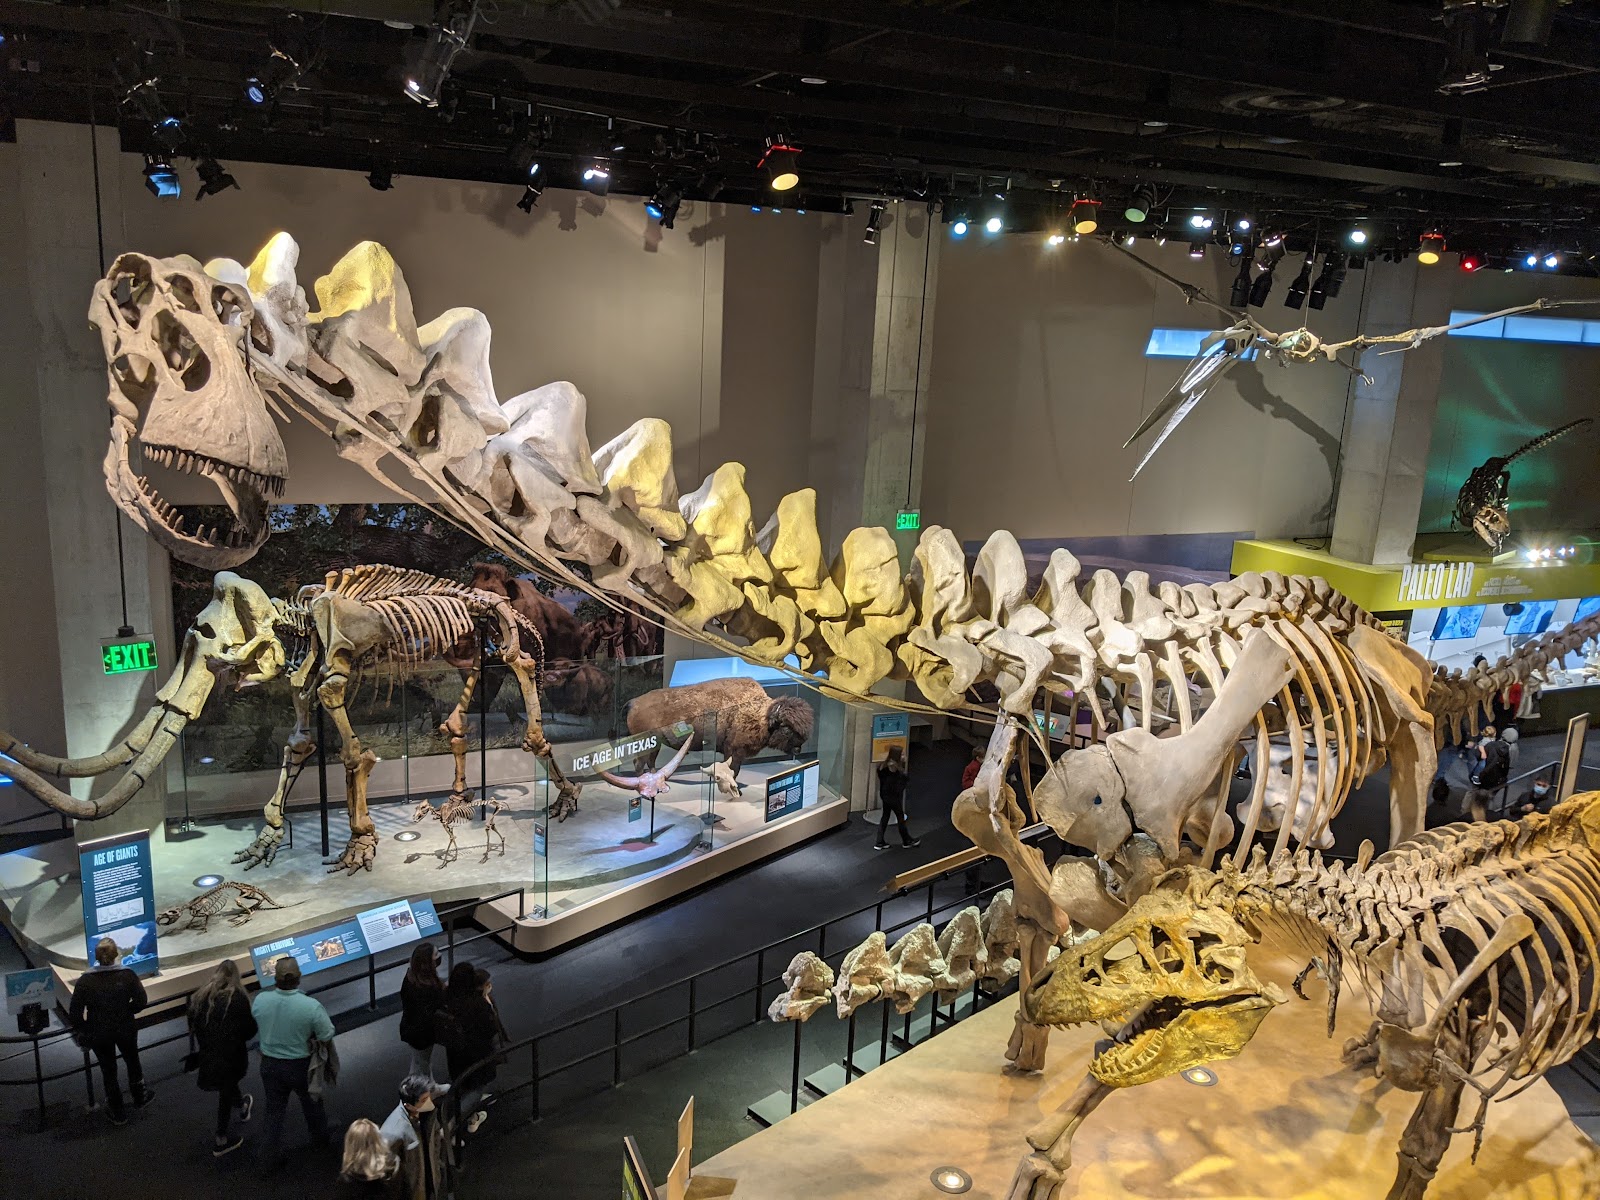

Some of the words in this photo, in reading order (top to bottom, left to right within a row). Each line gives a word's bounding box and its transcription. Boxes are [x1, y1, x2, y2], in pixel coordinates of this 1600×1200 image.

[900, 513, 918, 528] EXIT
[1398, 563, 1445, 602] PALEO
[1445, 562, 1475, 599] LAB
[109, 643, 150, 671] EXIT
[573, 755, 590, 772] ICE
[592, 749, 612, 766] AGE
[614, 745, 625, 759] IN
[626, 735, 657, 755] TEXAS
[94, 853, 106, 866] AGE
[107, 850, 114, 863] OF
[116, 845, 138, 861] GIANTS
